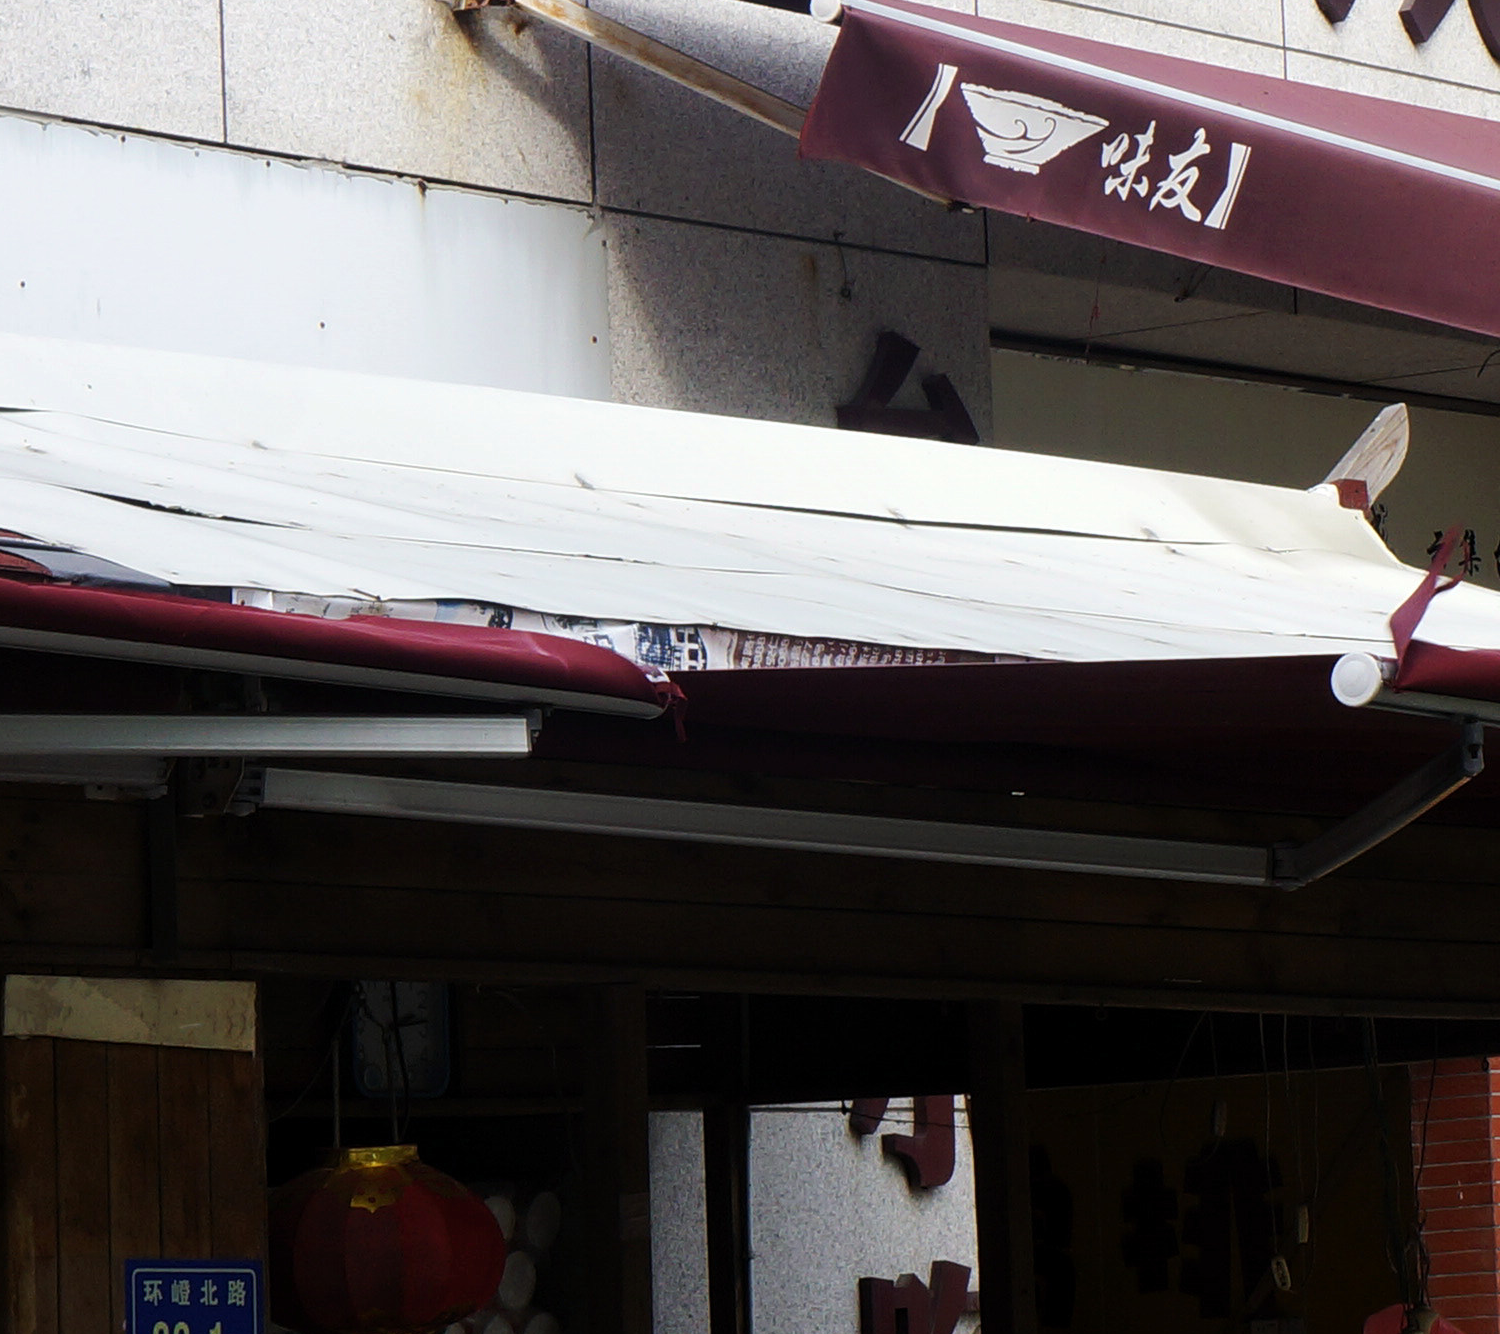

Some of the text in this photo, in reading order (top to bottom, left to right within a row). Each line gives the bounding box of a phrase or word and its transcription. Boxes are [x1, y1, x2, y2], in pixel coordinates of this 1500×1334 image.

[1100, 119, 1202, 223] 味友
[142, 1278, 247, 1308] 环嶝北路
